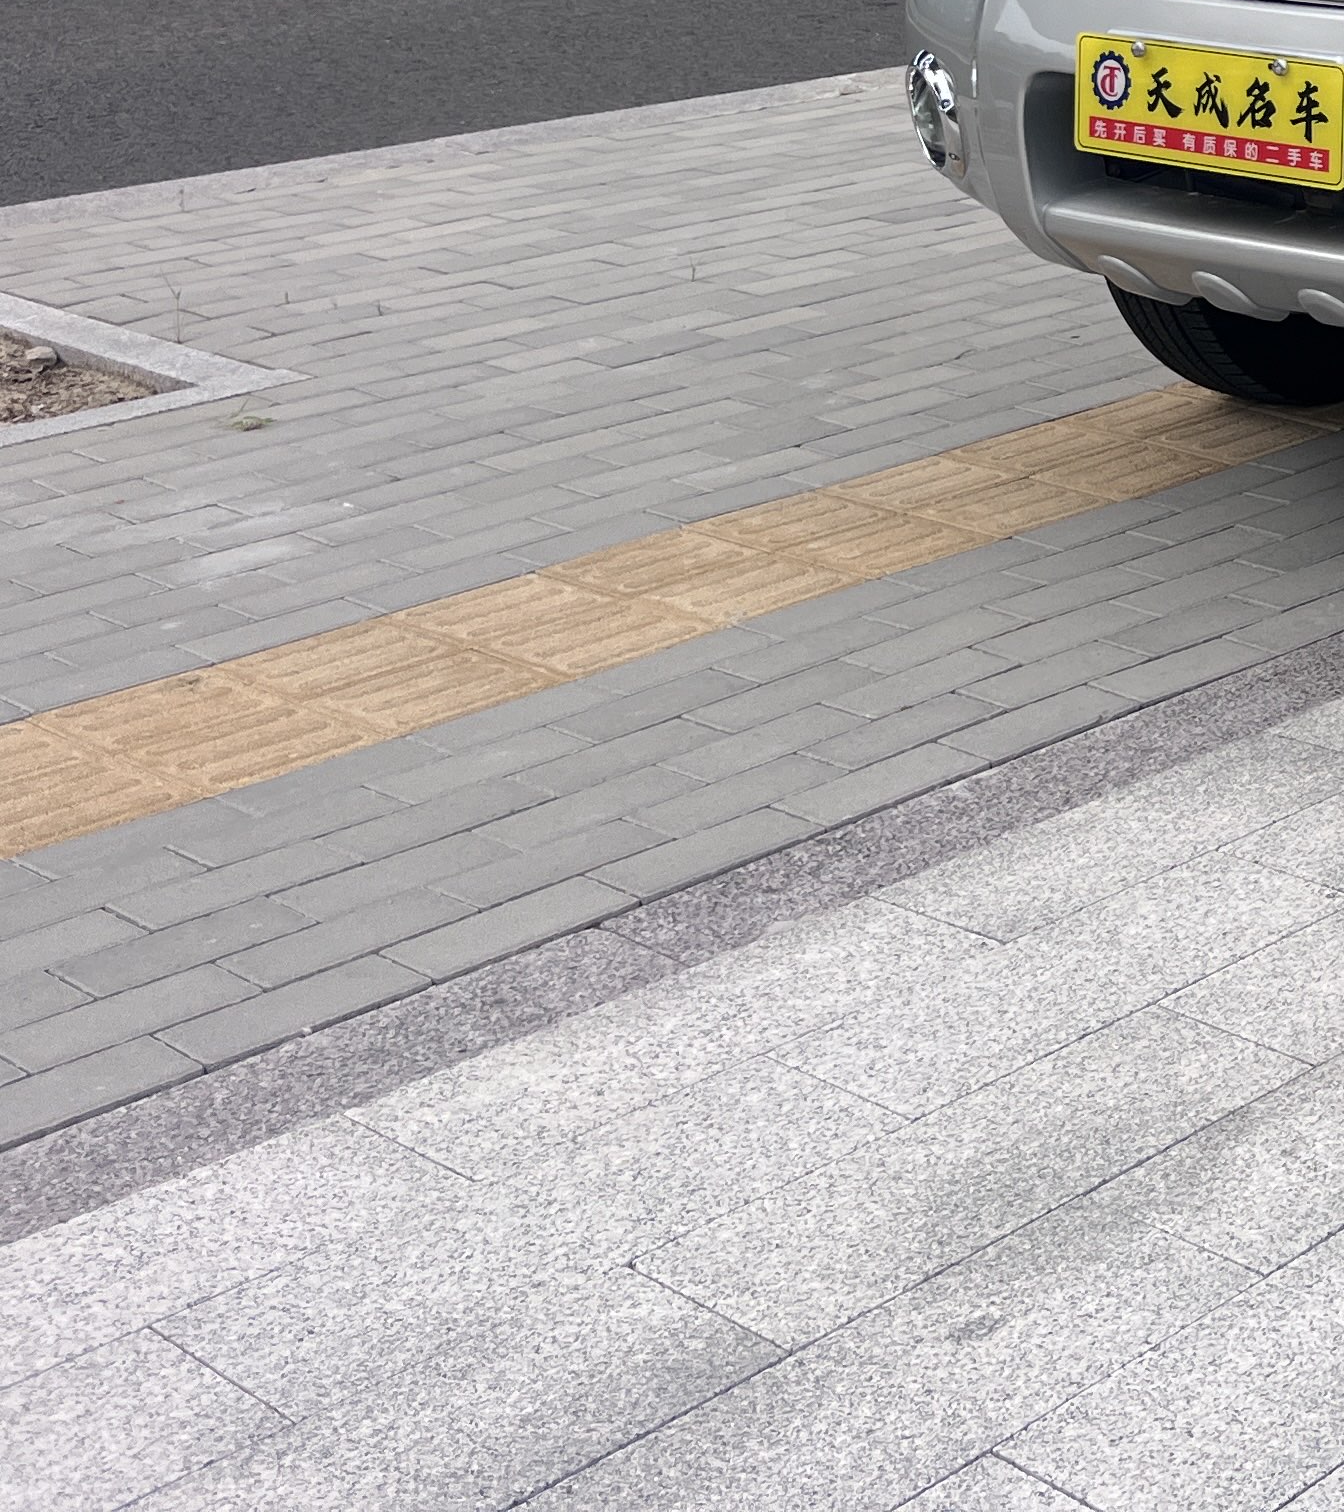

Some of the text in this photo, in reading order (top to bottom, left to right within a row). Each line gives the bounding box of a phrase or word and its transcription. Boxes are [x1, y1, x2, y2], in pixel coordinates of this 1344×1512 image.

[1147, 67, 1329, 143] 天成名车
[1093, 119, 1324, 170] 先开后买 有质保的二手车
